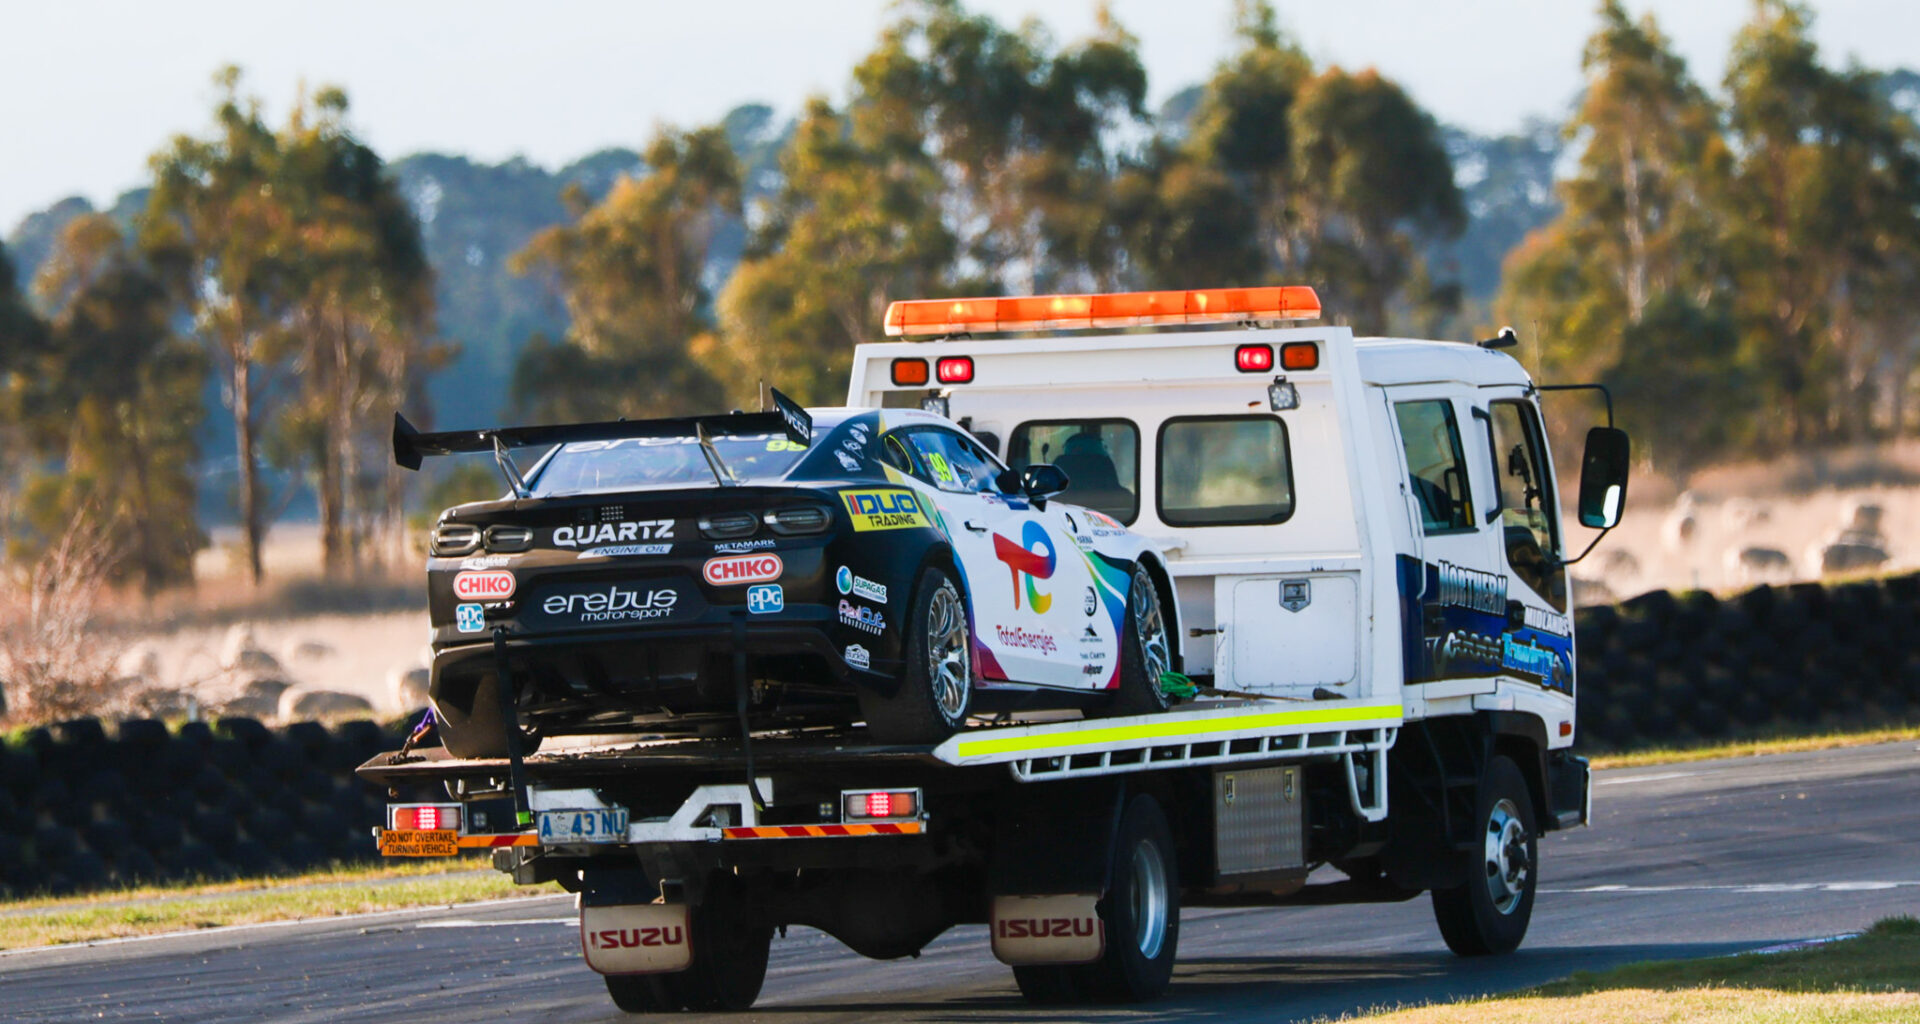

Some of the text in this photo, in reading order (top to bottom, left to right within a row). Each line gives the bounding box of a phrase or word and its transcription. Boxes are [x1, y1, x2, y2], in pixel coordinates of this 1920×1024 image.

[927, 452, 953, 482] 99
[855, 494, 918, 514] DUO
[868, 514, 917, 527] TRADING
[553, 519, 676, 548] QUARTZ
[592, 545, 666, 556] ENGINE OIL
[714, 539, 776, 552] METAMARK
[709, 558, 778, 580] CHIKO
[458, 576, 511, 594] CHIKO
[854, 577, 886, 597] SUPAGAS
[1438, 559, 1508, 616] NORTHERN
[543, 586, 678, 615] erebus
[749, 588, 781, 610] PPG
[457, 607, 483, 630] PPG
[581, 607, 674, 622] motorsport
[1524, 605, 1569, 638] MIDLANDS
[996, 625, 1057, 656] TotalEnergies
[1501, 632, 1554, 687] Towing
[541, 811, 626, 837] A 43 NU
[385, 832, 453, 843] DO NOT OVERTAKE
[388, 844, 452, 854] TURNING VEHICLE
[590, 925, 683, 950] ISUZU
[999, 917, 1094, 939] ISUZU
